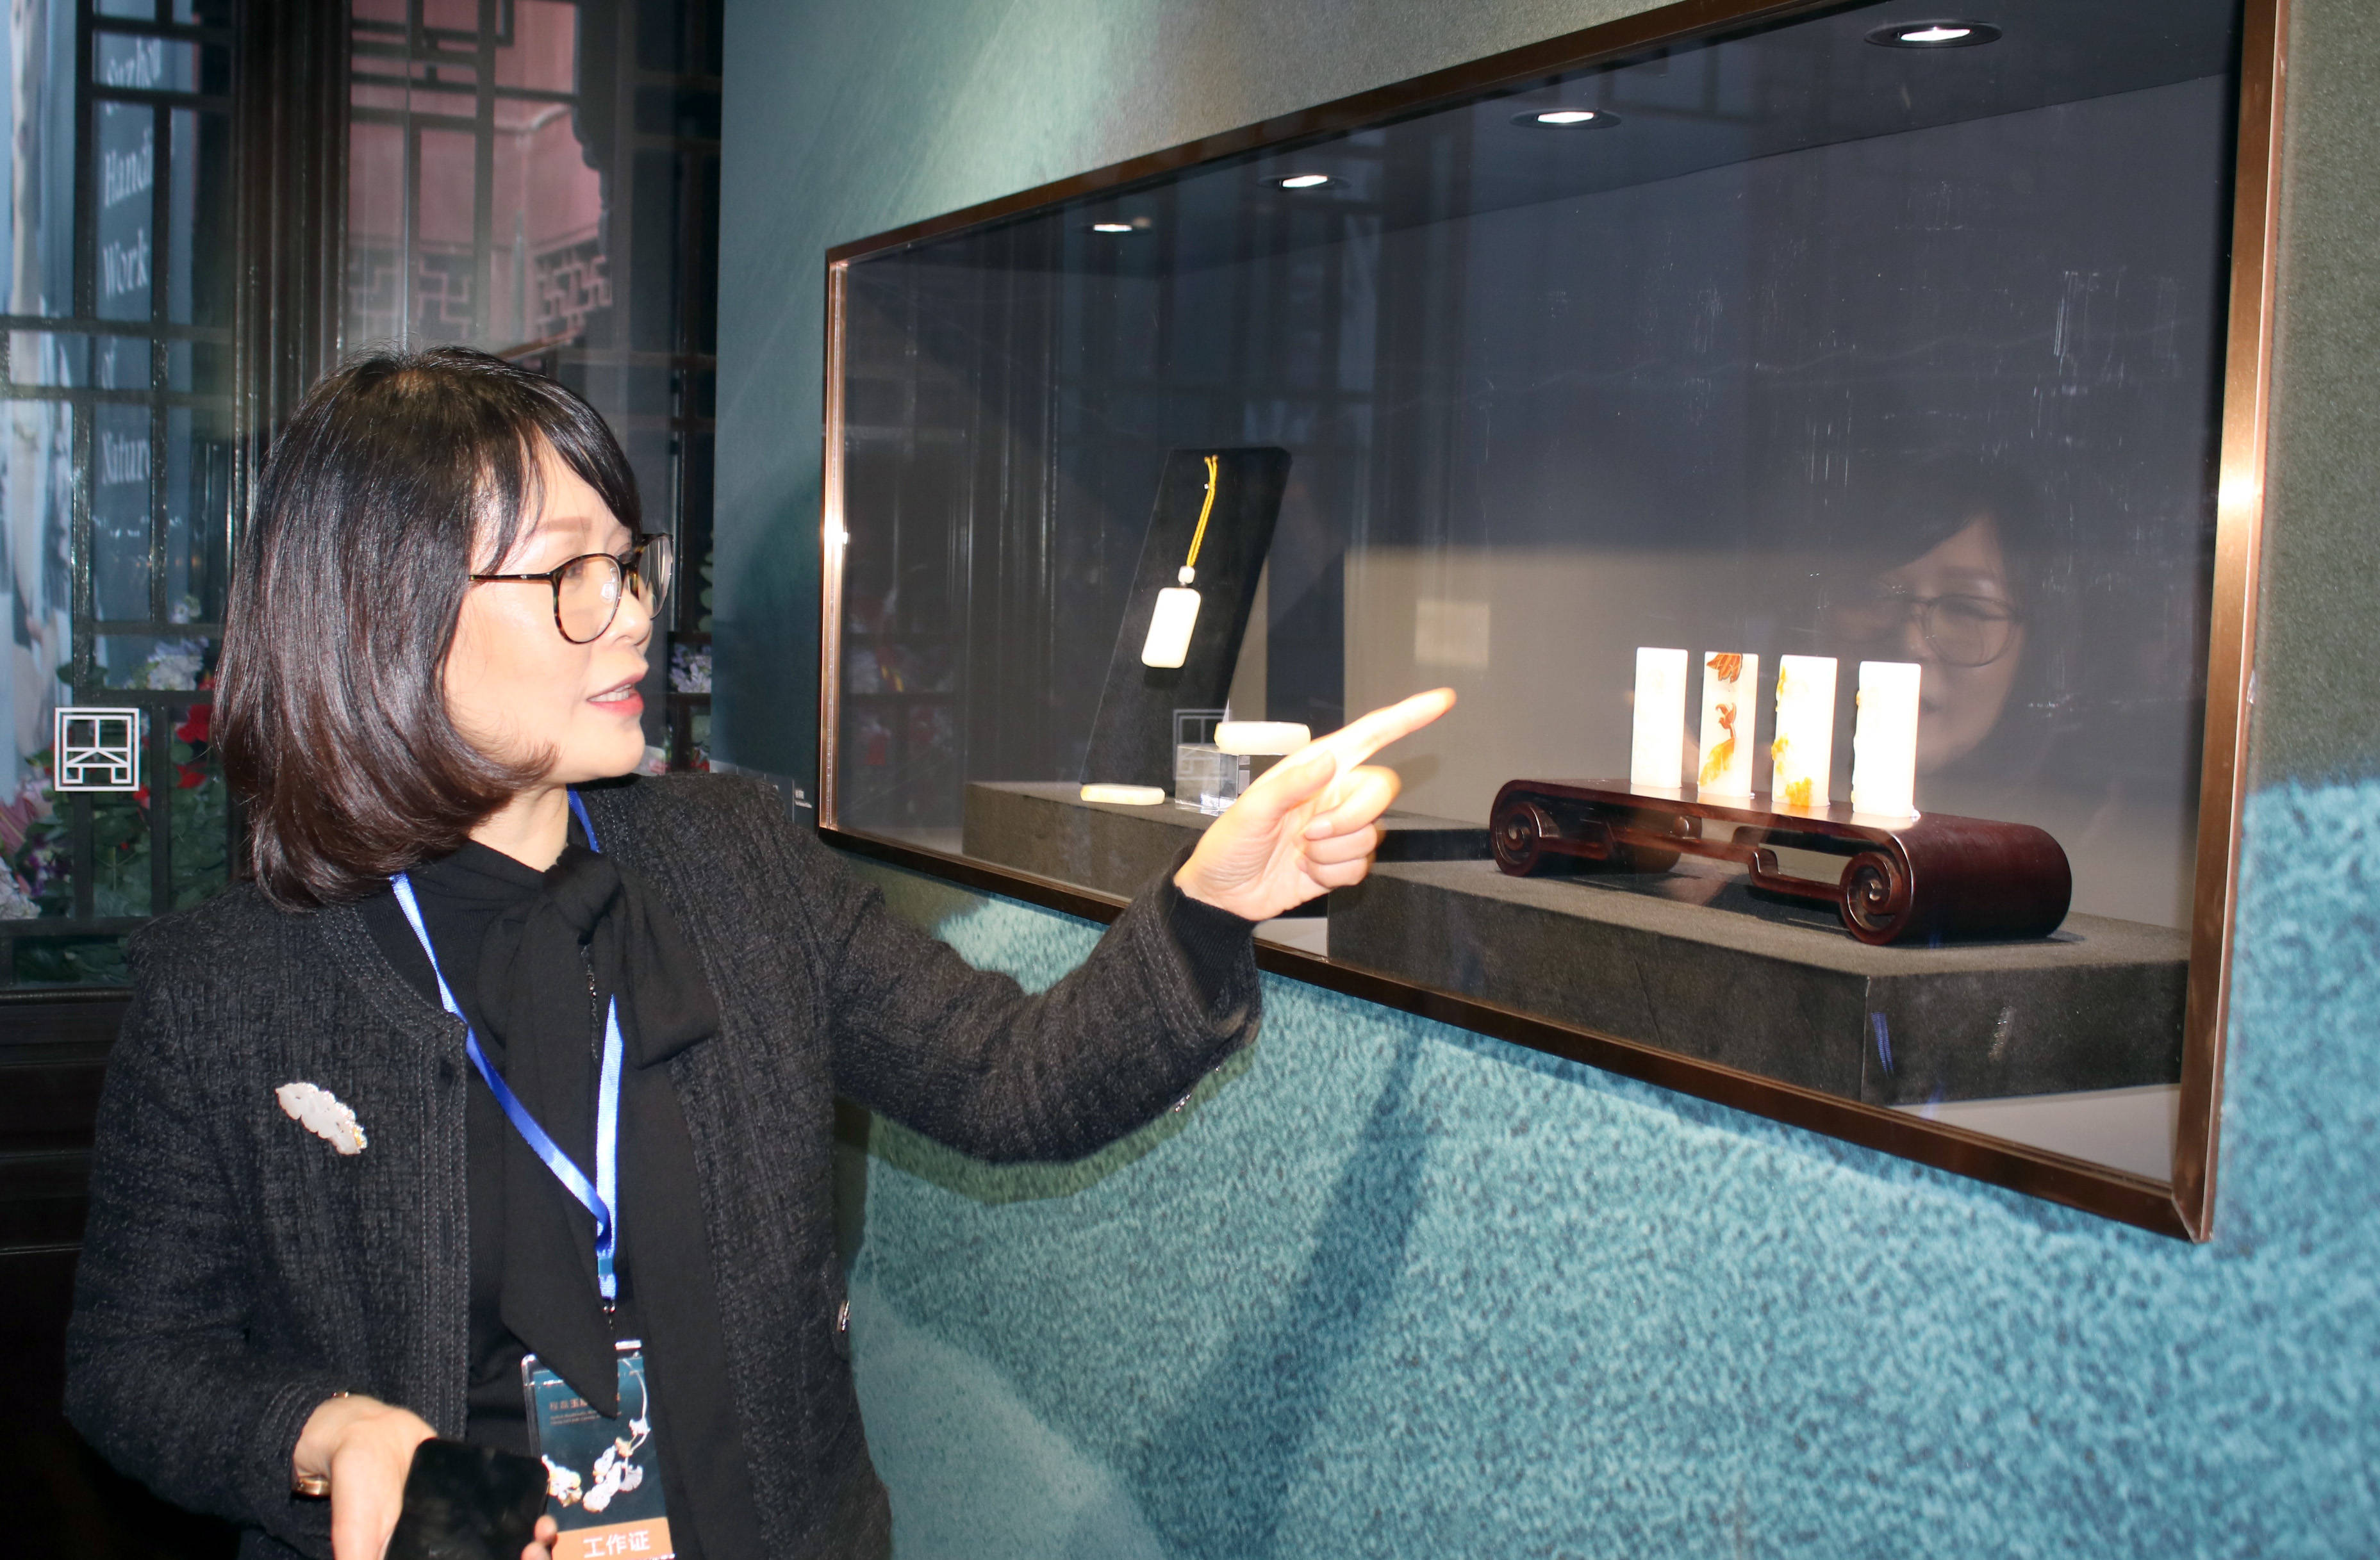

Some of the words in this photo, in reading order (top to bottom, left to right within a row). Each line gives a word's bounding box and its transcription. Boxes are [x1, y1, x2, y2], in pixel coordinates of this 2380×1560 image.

[103, 228, 149, 299] Work
[583, 1530, 651, 1559] 工作证
